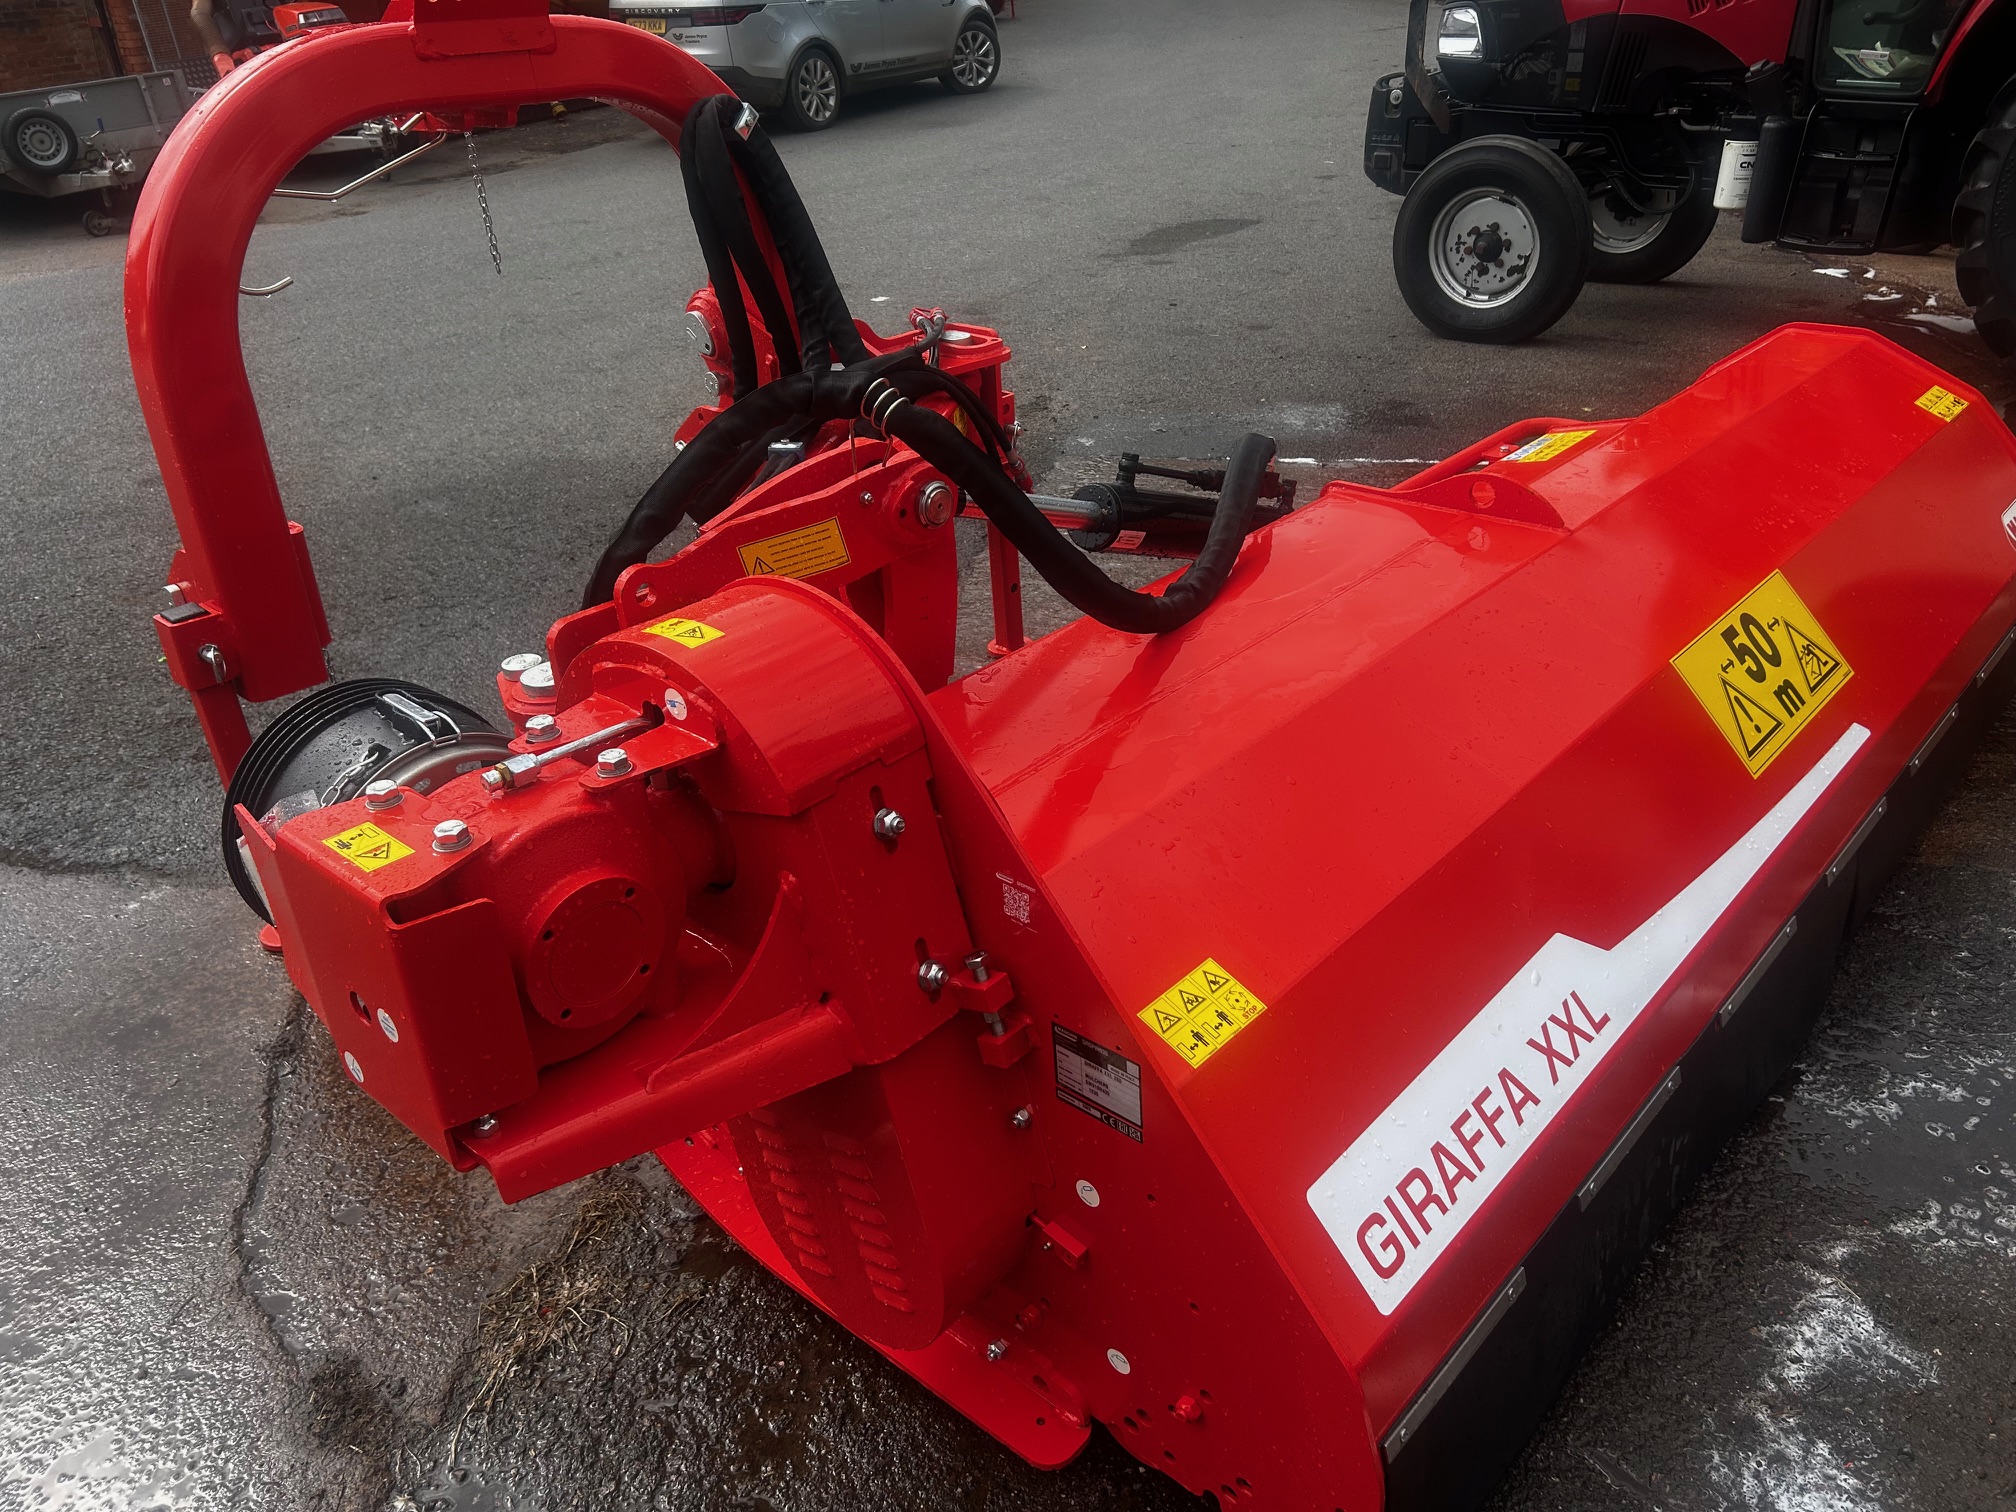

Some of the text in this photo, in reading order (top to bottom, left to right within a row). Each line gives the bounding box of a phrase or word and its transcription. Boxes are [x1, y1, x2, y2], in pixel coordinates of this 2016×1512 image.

[863, 62, 881, 70] James
[881, 60, 897, 68] Pryce
[1720, 612, 1782, 684] 50
[1772, 678, 1807, 719] m
[1242, 1004, 1258, 1020] STOP
[1355, 990, 1612, 1280] GIRAFFA XXL
